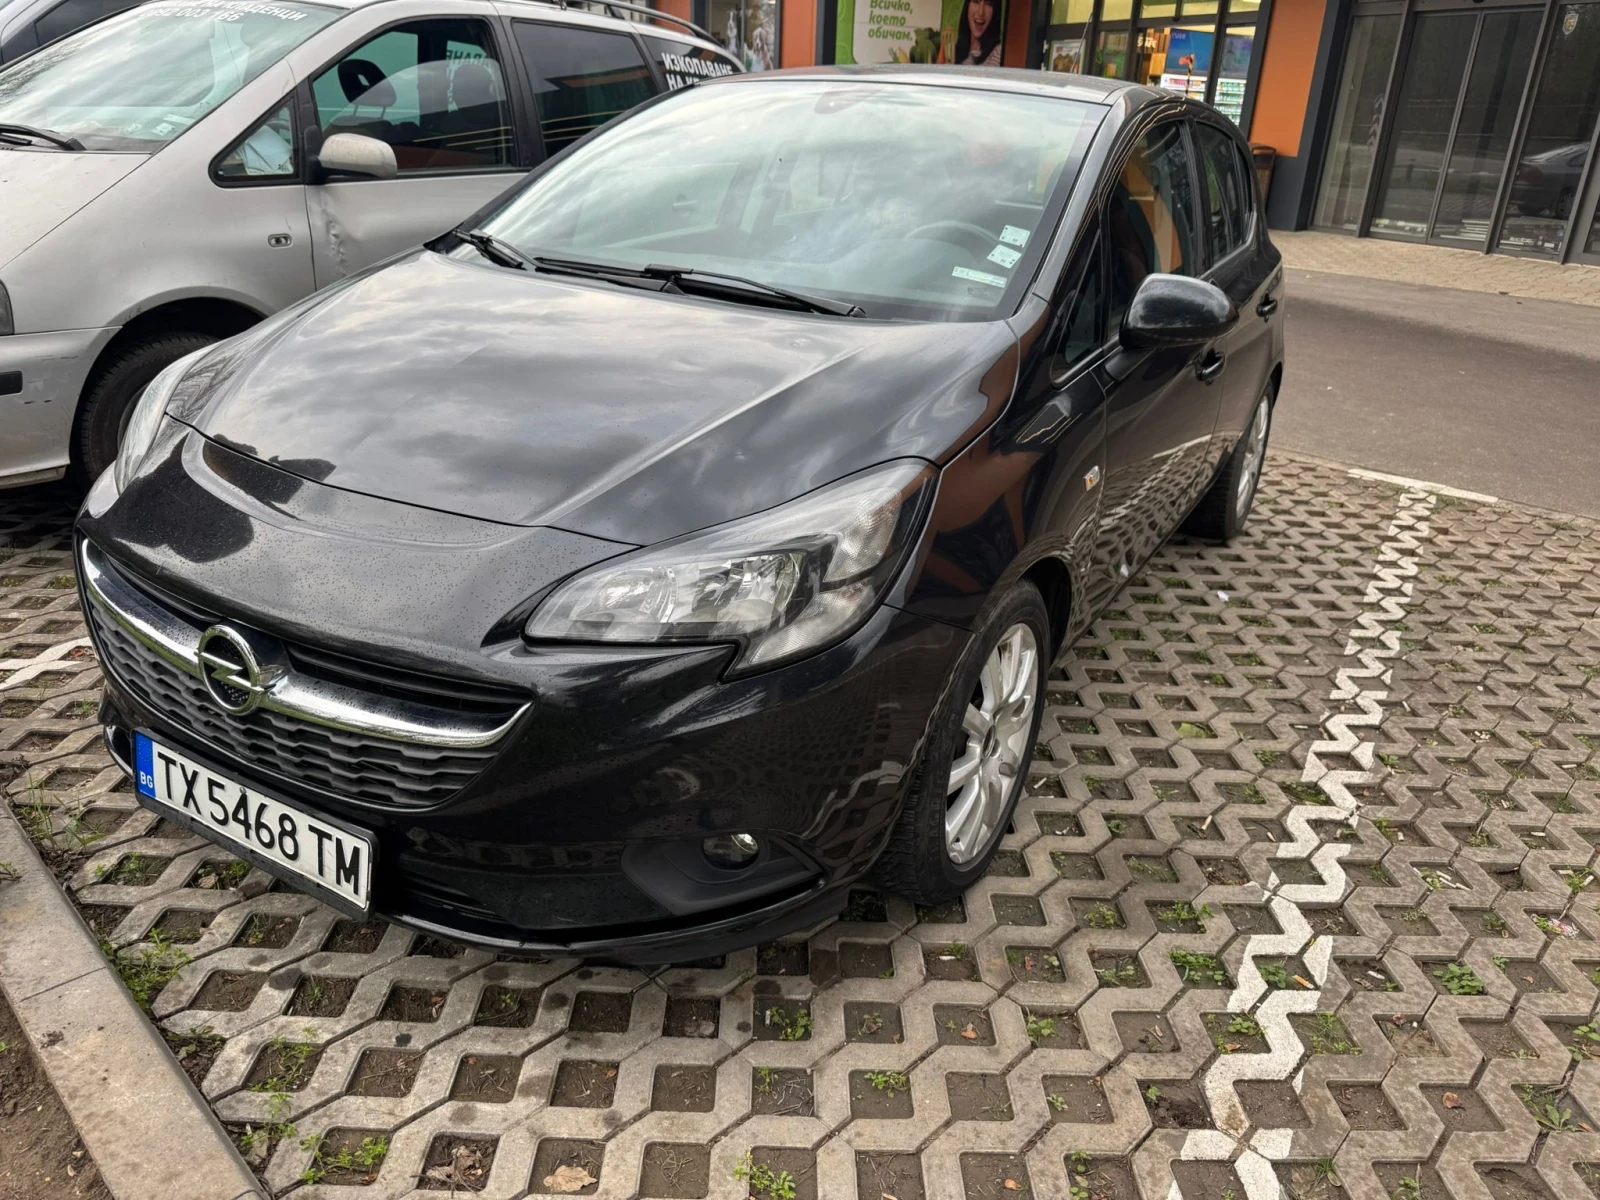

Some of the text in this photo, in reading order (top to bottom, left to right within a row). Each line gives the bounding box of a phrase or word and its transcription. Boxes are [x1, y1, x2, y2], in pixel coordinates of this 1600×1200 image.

[175, 8, 211, 18] 003
[205, 10, 245, 21] 166
[869, 0, 913, 15] Всичко,
[869, 10, 906, 26] което
[867, 24, 913, 41] обичам.
[661, 52, 734, 77] ИЗКОПАВАНЕ
[139, 770, 154, 789] BG
[308, 823, 361, 897] TM
